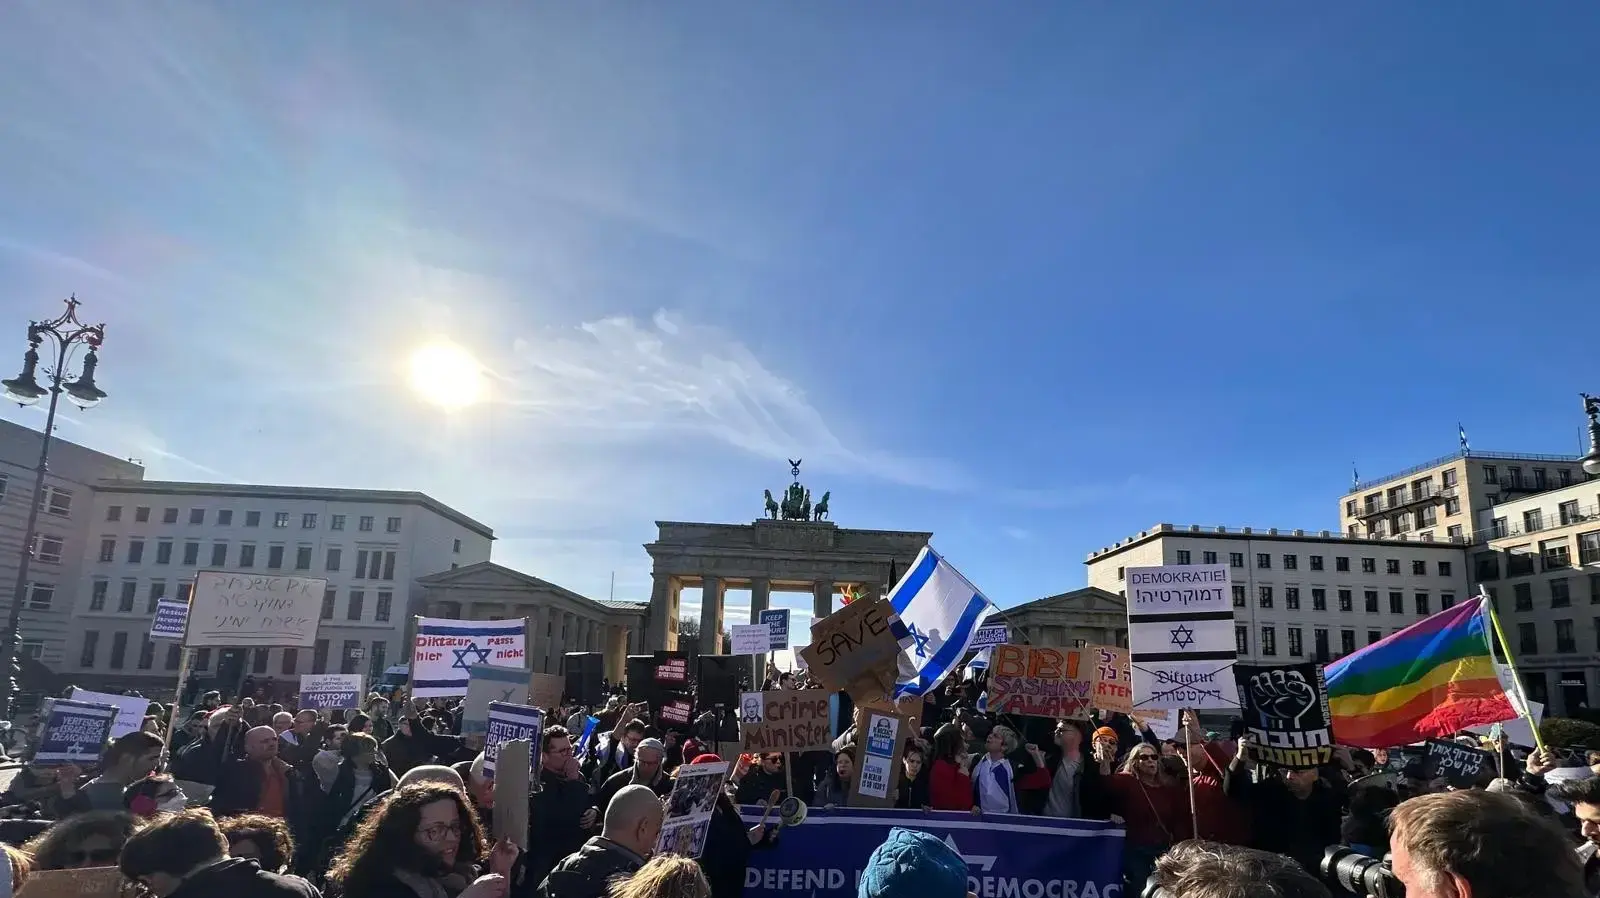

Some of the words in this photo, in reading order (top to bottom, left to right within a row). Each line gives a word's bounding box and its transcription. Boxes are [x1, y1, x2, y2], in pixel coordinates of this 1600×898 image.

[1132, 569, 1226, 585] DEMOKRATIE!
[1136, 588, 1223, 605] דמוקרטיה!
[765, 614, 783, 622] KEEP
[415, 636, 472, 647] Diktatur
[816, 609, 888, 666] SAVE
[496, 648, 524, 659] nicht
[996, 647, 1081, 680] BIBI
[994, 676, 1091, 698] SASHAY
[489, 721, 518, 738] RETTET
[743, 866, 846, 890] DEFEND
[966, 875, 1124, 898] DEMOCRAC
